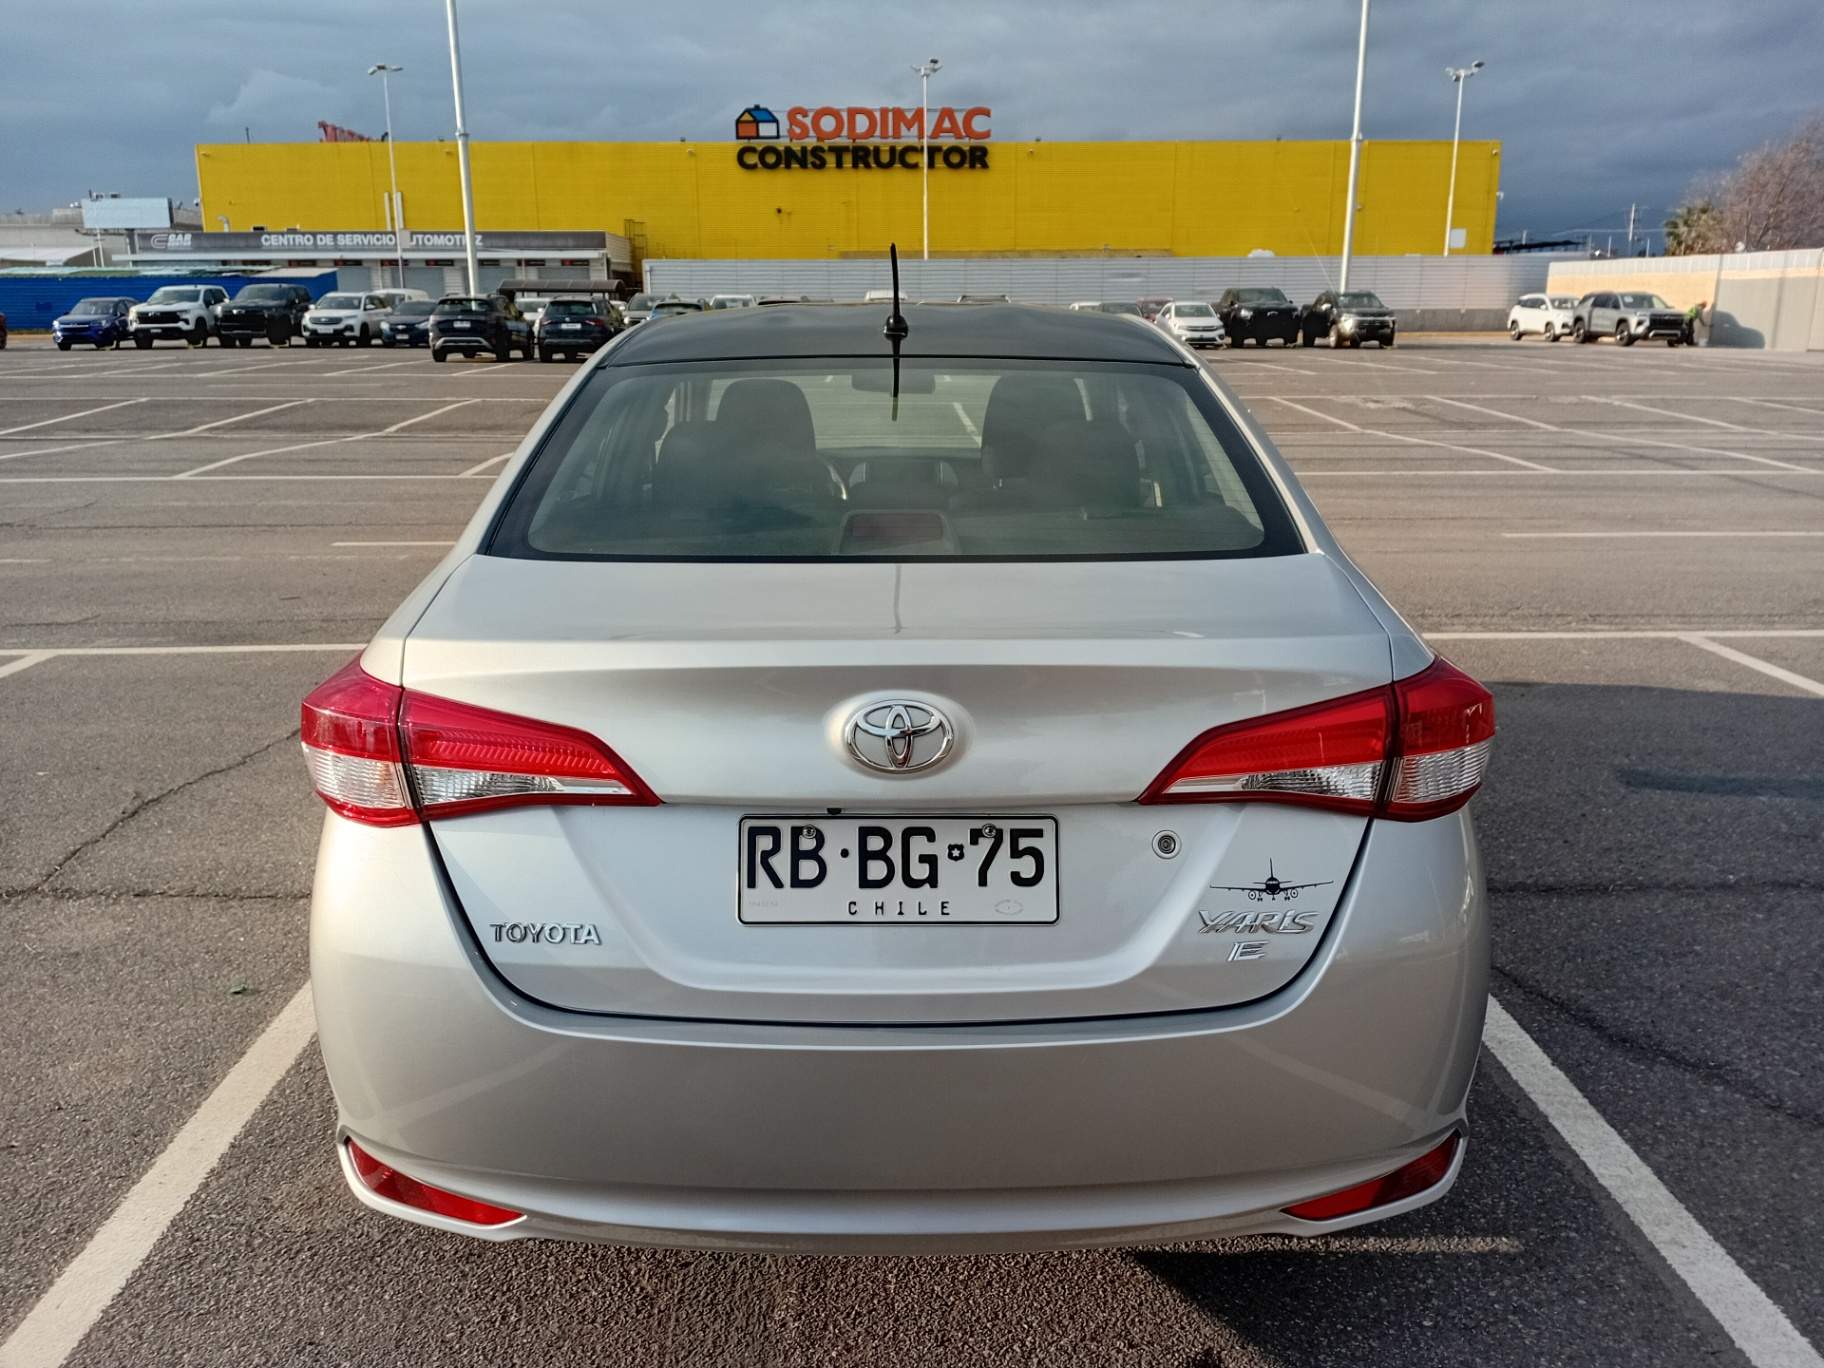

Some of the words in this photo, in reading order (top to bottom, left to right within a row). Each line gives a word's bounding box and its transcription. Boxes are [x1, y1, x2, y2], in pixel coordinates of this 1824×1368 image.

[787, 106, 992, 140] SODIMAC
[736, 144, 990, 170] CONSTRUCTOR
[261, 234, 314, 246] CENTRO
[317, 235, 333, 246] DE
[336, 235, 396, 246] SERVICIO
[847, 901, 952, 916] CHILE
[489, 922, 603, 946] TOYOTA
